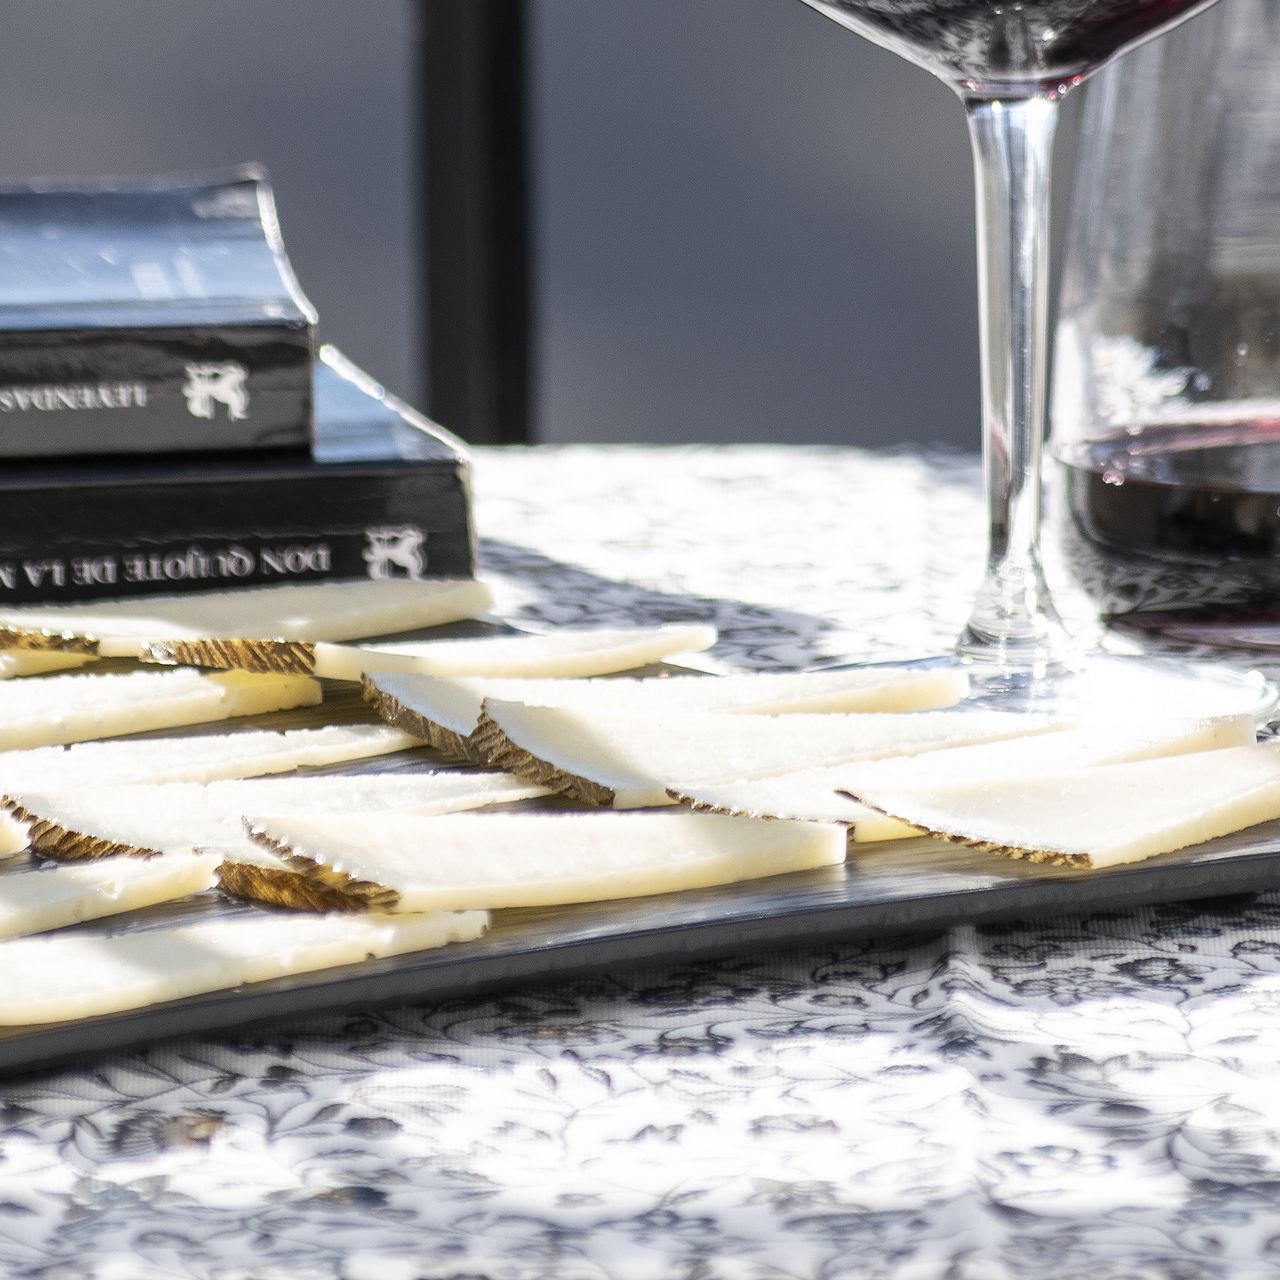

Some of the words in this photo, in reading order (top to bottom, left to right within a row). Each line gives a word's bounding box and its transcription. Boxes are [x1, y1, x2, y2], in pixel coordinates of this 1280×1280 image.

[23, 558, 66, 588] LA
[71, 555, 117, 586] DE
[123, 544, 255, 582] QUIJOTE
[261, 543, 332, 574] DON
